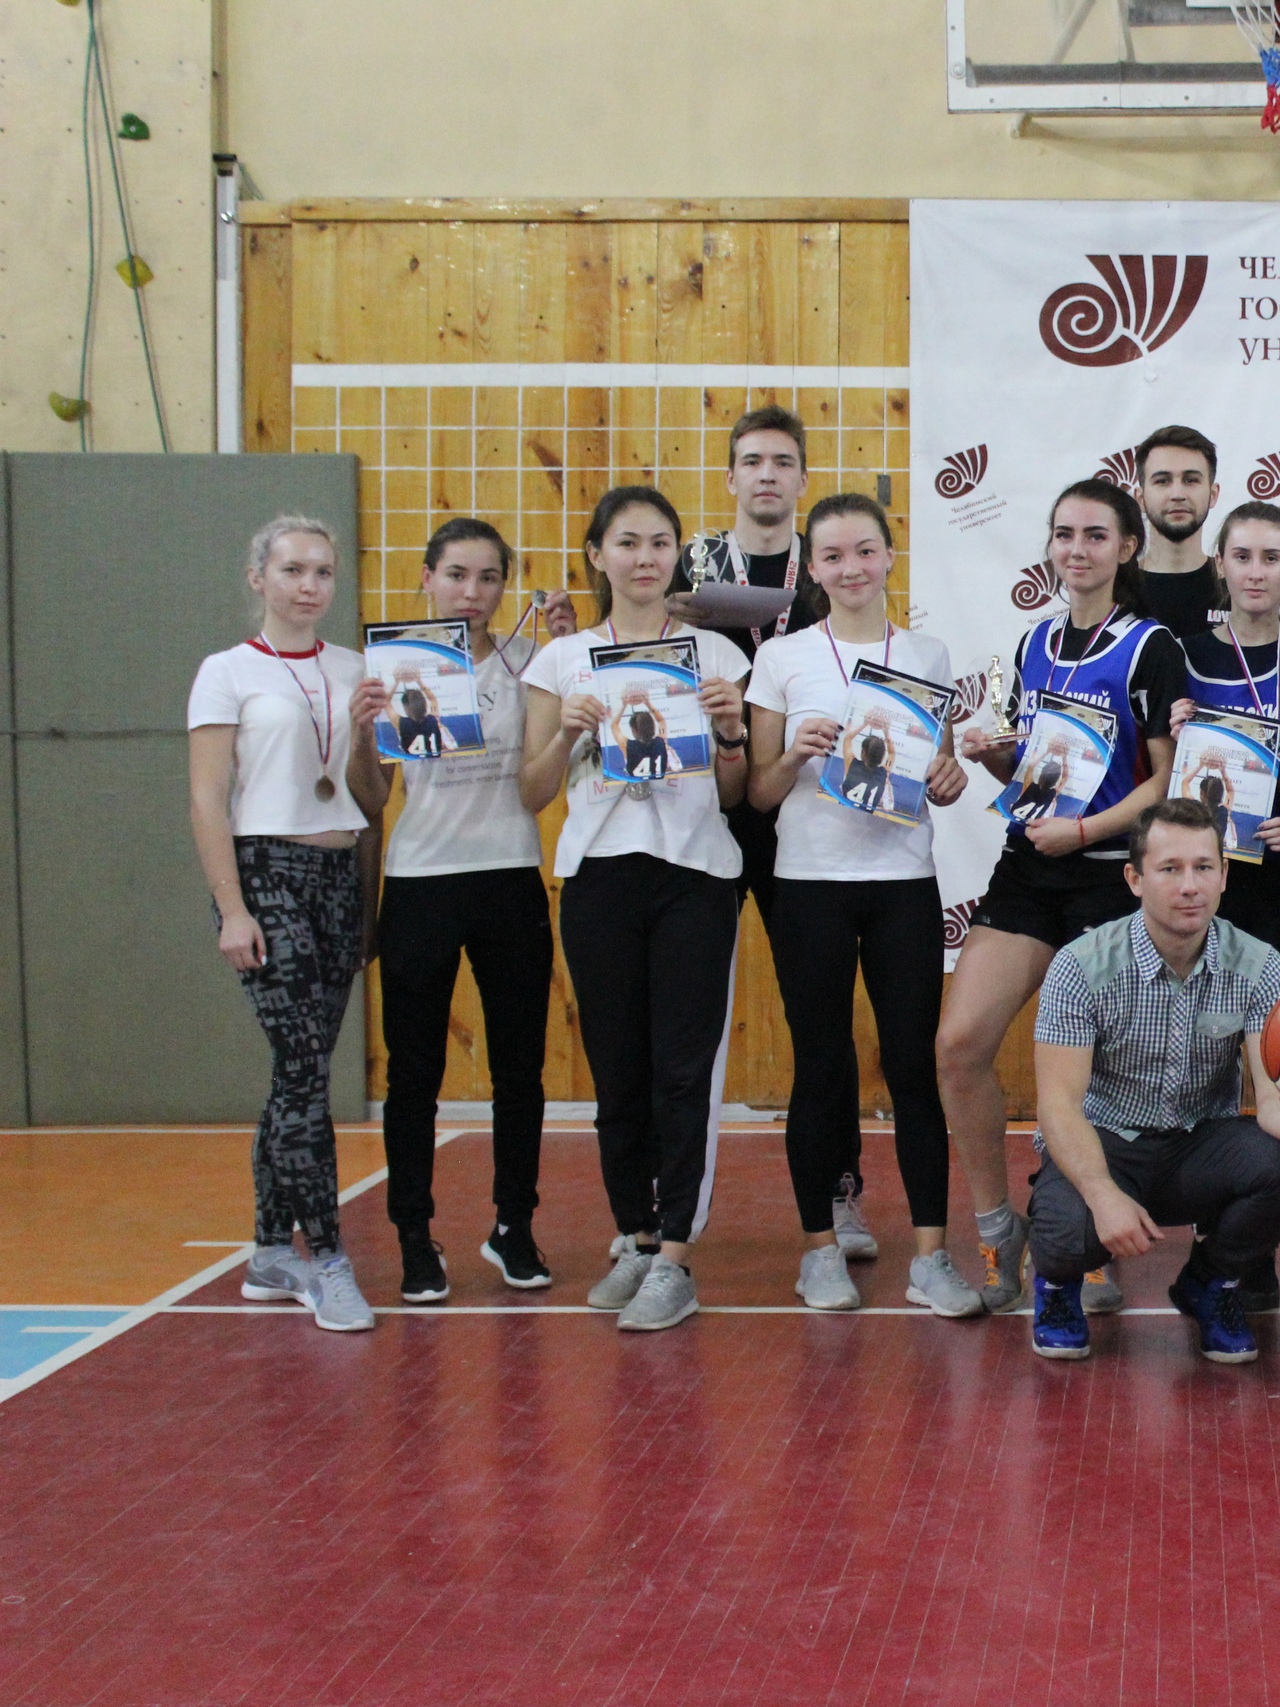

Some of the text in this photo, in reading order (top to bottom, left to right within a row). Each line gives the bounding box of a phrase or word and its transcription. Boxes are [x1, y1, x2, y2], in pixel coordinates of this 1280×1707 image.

[948, 500, 1008, 526] государственный
[950, 493, 997, 514] Челябинский
[959, 512, 1003, 533] университет
[407, 733, 439, 758] 41
[632, 755, 664, 780] 41
[846, 782, 879, 811] 41
